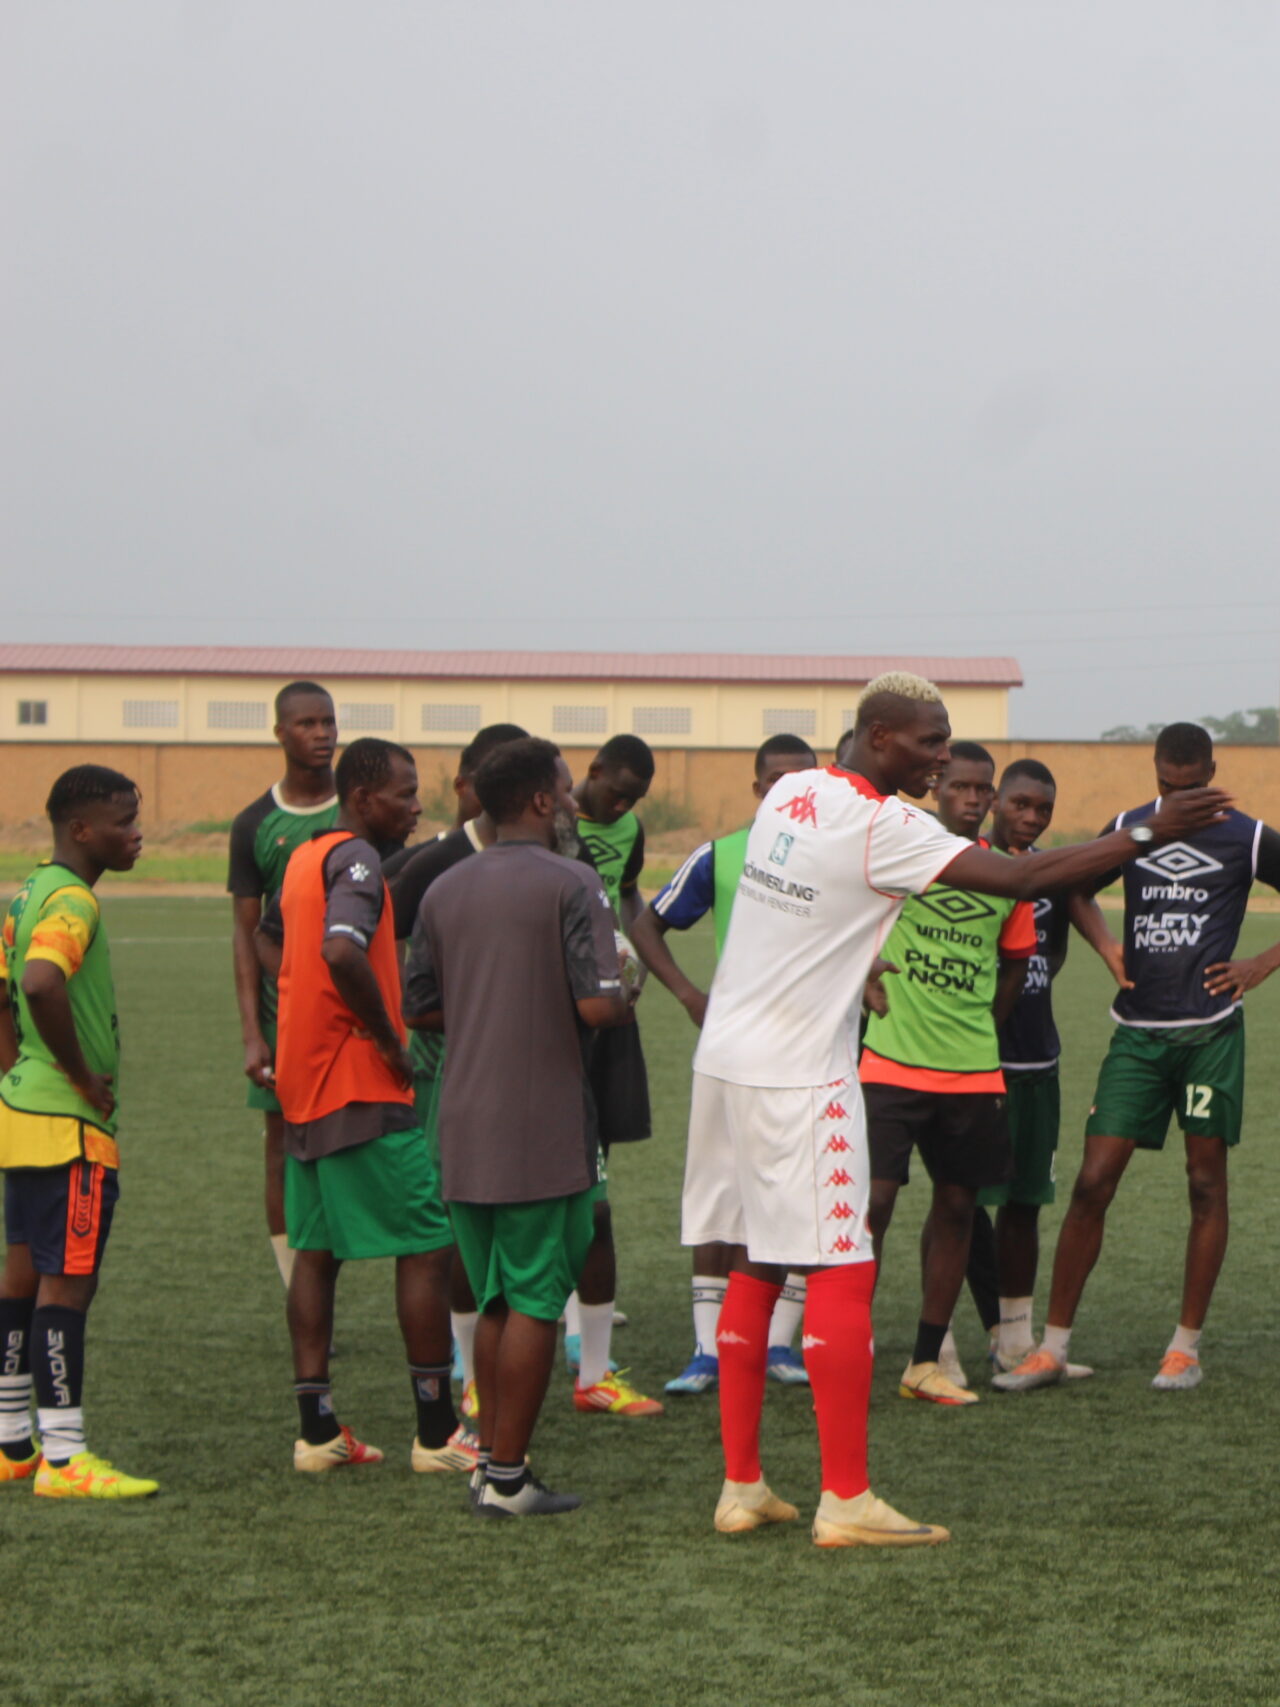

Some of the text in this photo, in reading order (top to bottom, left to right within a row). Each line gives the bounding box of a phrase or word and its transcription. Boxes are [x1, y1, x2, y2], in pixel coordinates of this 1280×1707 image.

[743, 860, 813, 902] ÖMMERLING
[1141, 882, 1208, 902] umbro
[1134, 912, 1210, 933] PLAY
[916, 923, 983, 949] umbro
[1135, 929, 1200, 950] NOW
[905, 949, 983, 977] PLAY
[908, 967, 975, 993] NOW
[1185, 1083, 1213, 1118] 12
